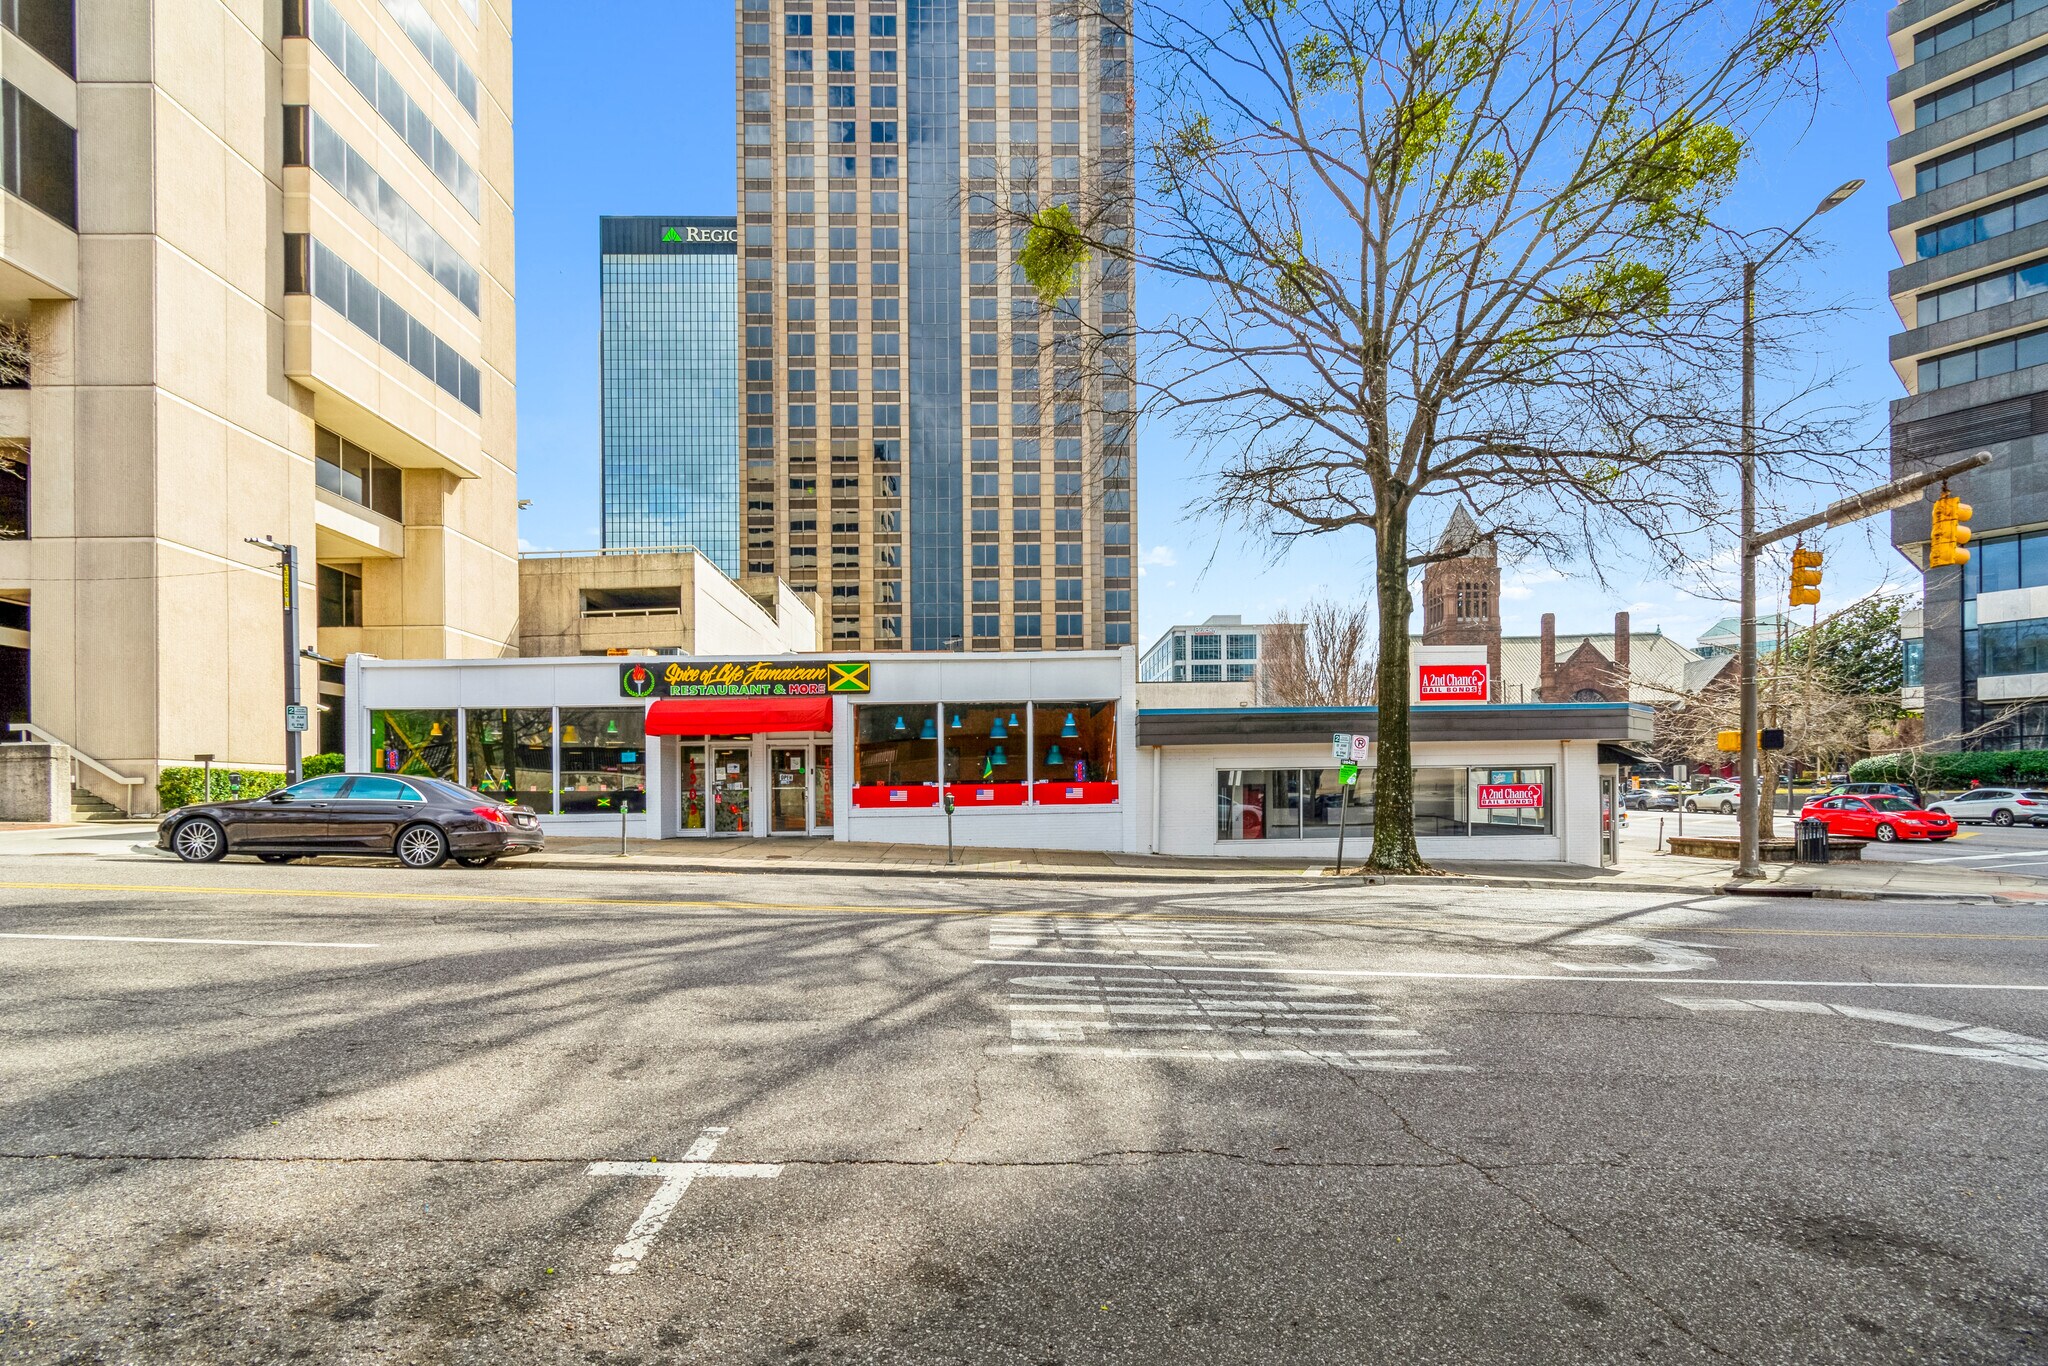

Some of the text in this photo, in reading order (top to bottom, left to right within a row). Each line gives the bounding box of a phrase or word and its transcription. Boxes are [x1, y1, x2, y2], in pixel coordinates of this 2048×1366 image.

[664, 661, 827, 686] Spice of Life Jamaican
[1422, 674, 1478, 686] A 2nd Chance
[670, 684, 826, 696] RESTAURANT & MORE
[1481, 788, 1533, 799] A 2nd Chance
